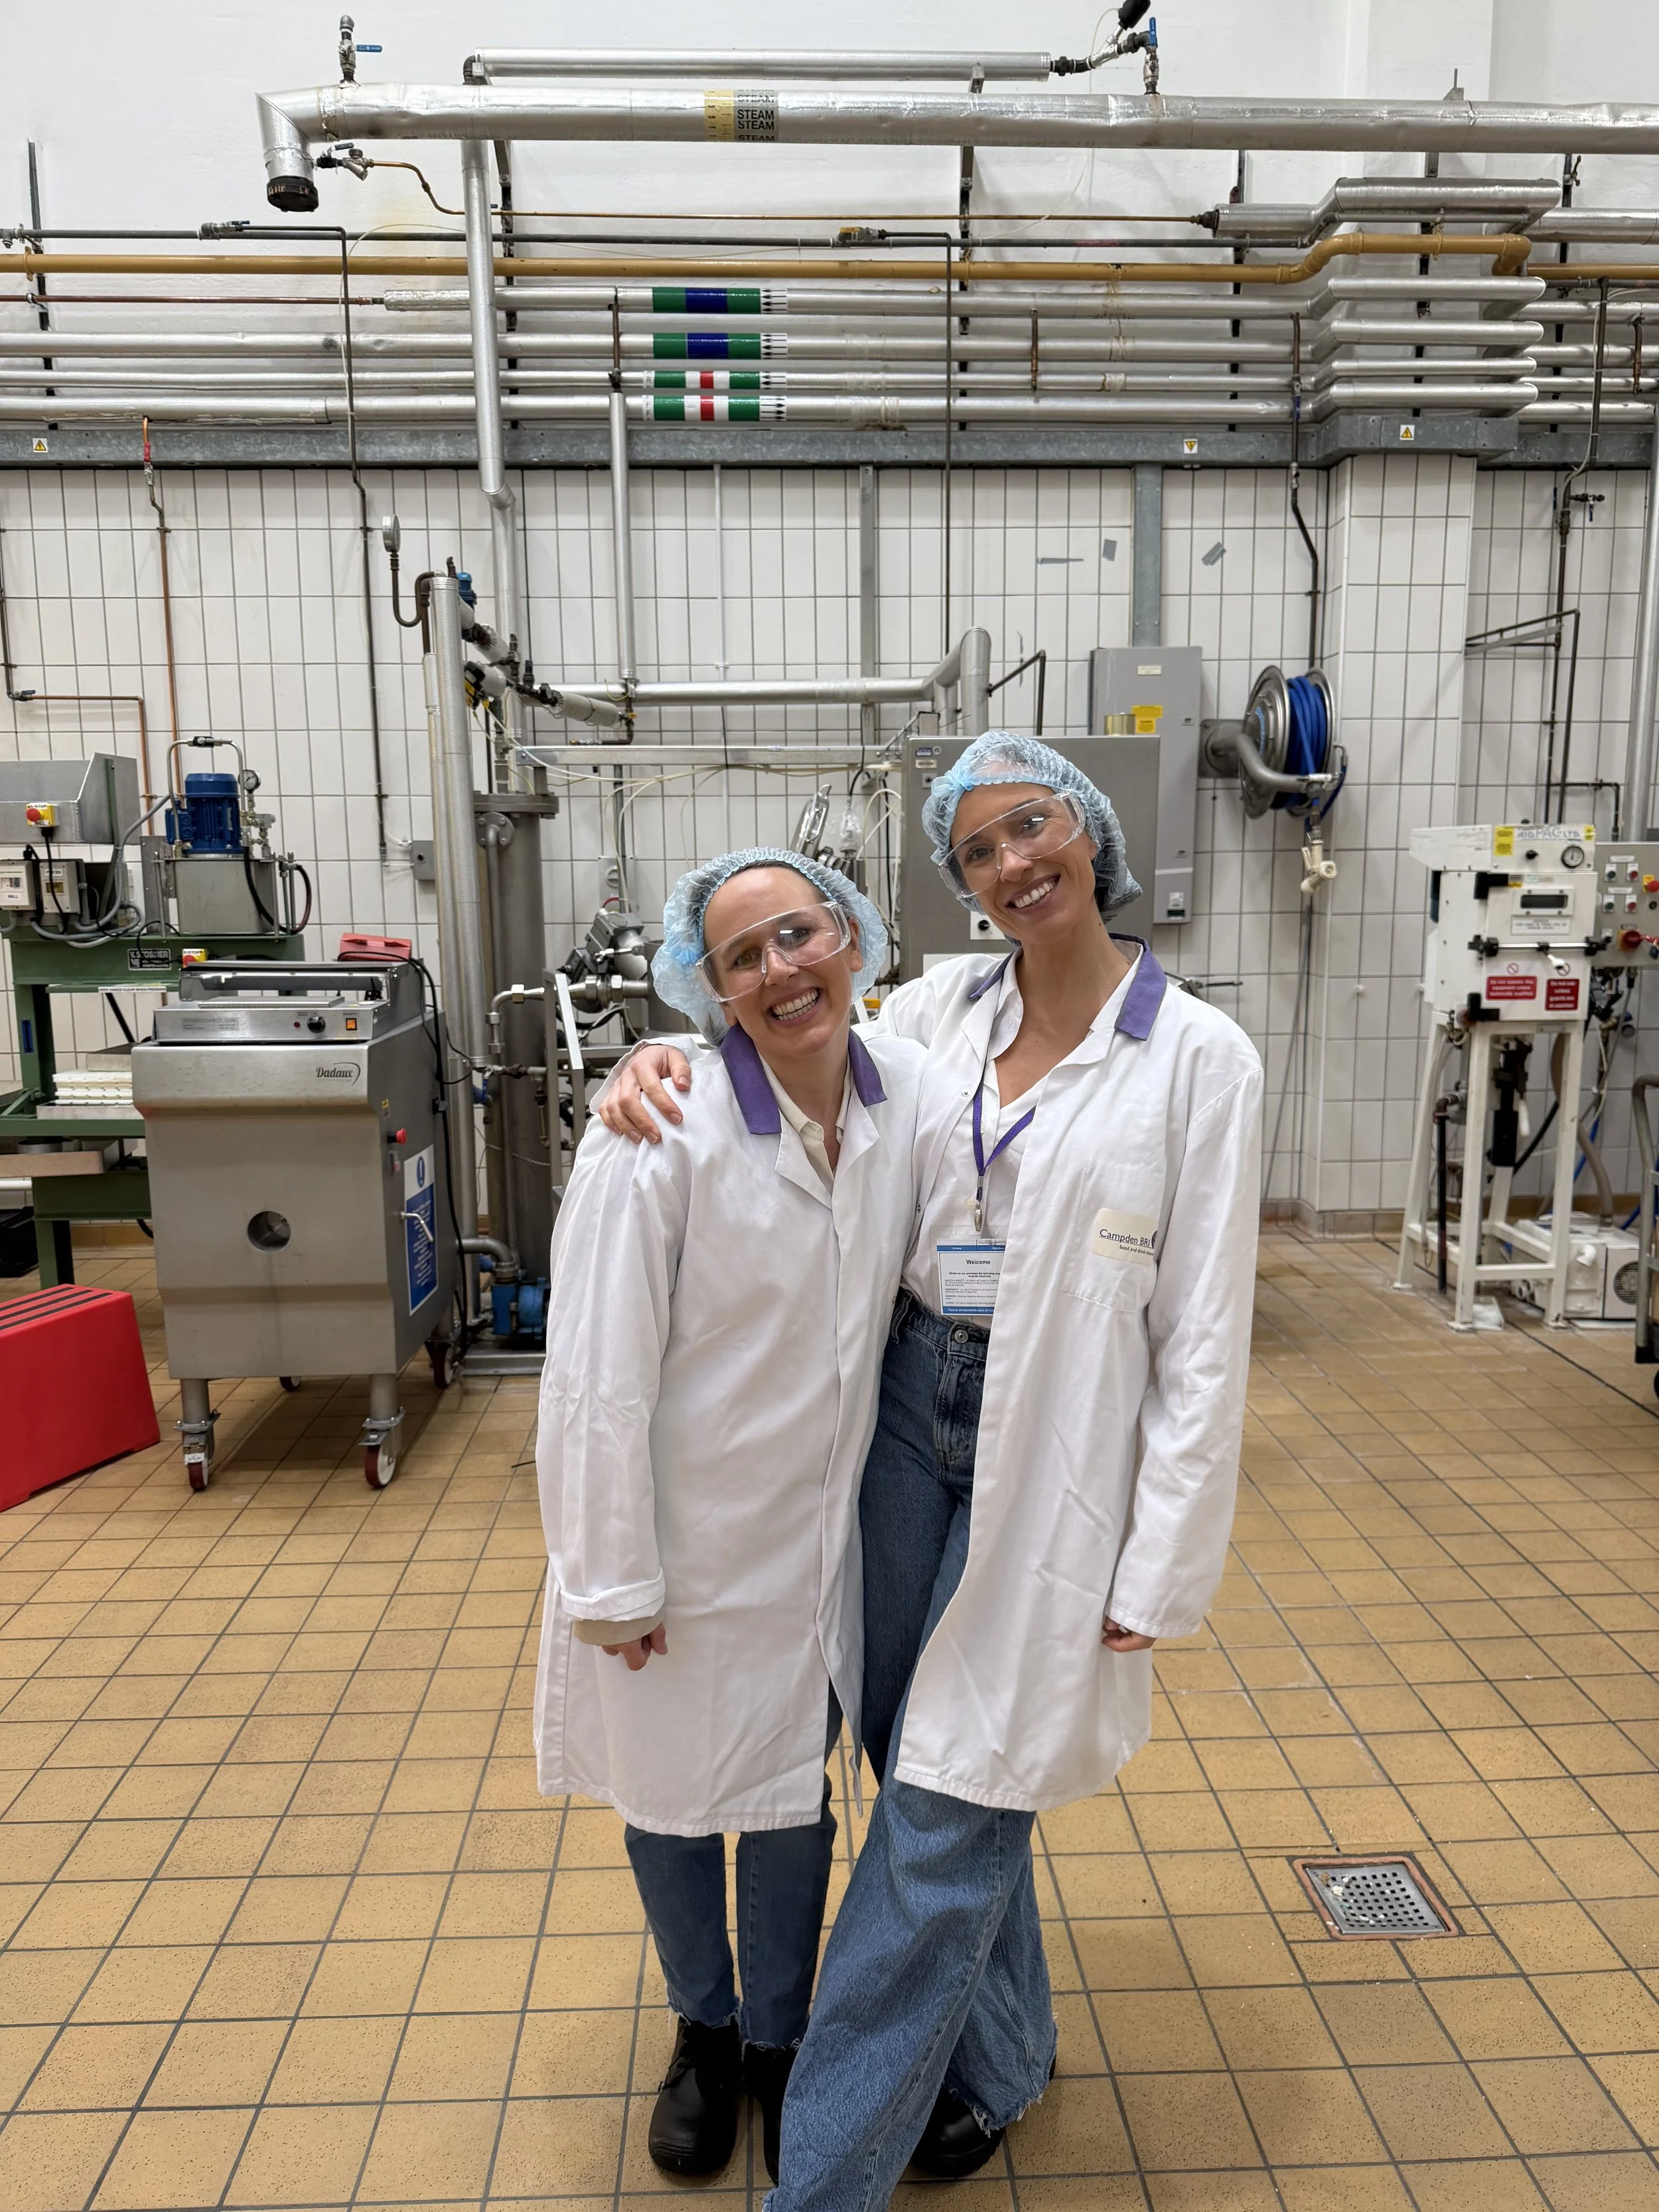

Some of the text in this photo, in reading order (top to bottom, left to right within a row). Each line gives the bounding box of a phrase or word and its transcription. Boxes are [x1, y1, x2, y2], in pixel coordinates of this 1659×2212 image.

[737, 110, 774, 119] STEAM
[737, 120, 774, 130] STEAM
[316, 1067, 353, 1078] Dadaux
[1100, 1228, 1151, 1246] Campden BRI
